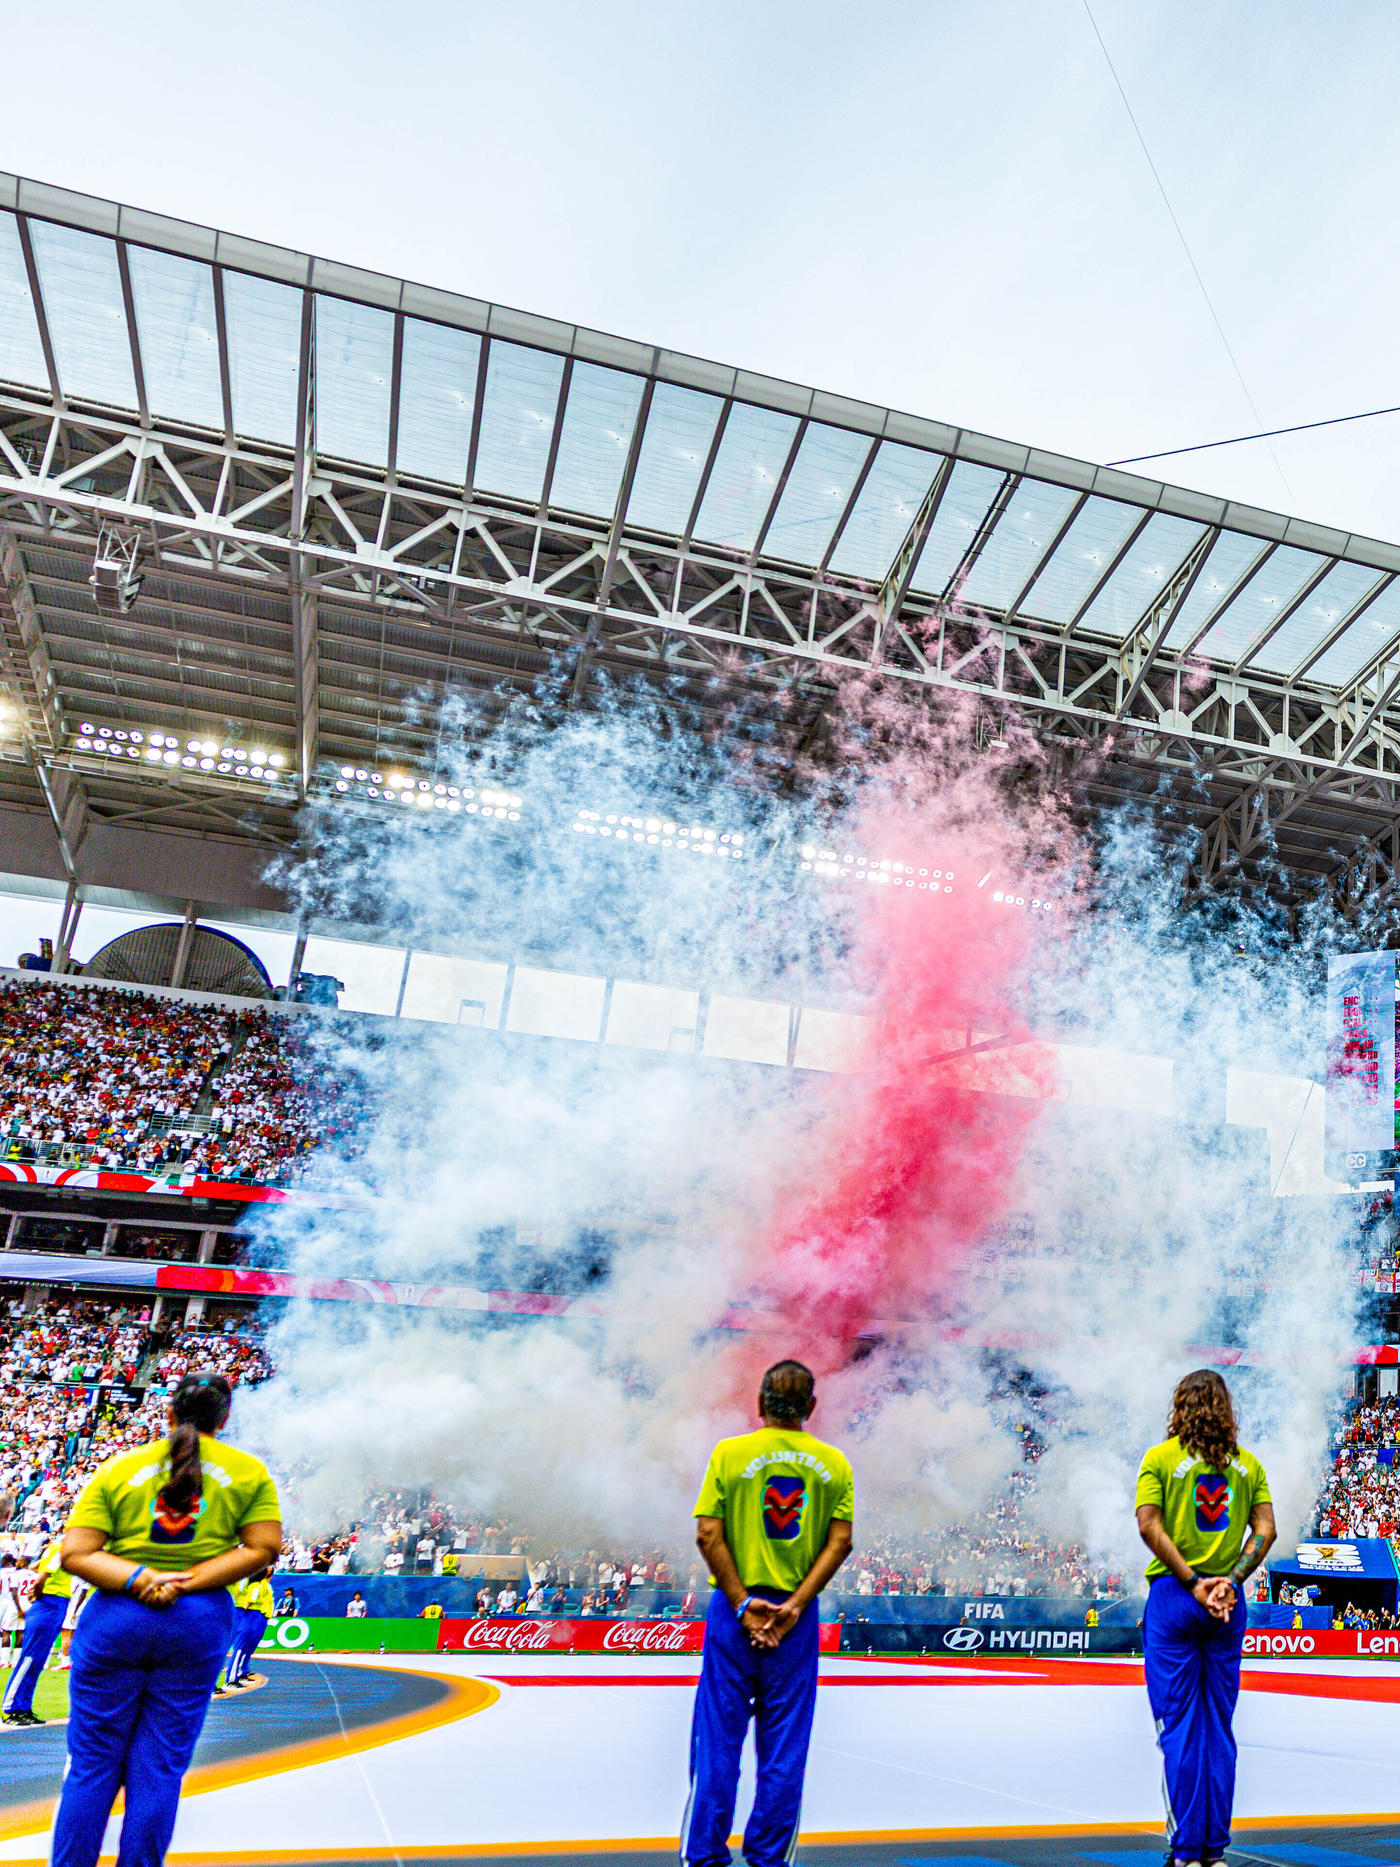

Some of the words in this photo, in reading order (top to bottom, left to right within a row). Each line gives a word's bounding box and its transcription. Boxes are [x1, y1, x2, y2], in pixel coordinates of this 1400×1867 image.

[964, 1602, 1005, 1619] FIFA
[463, 1619, 557, 1649] Coca-Cola
[603, 1620, 692, 1649] Coca-Cola
[989, 1630, 1090, 1649] HYUNDAI
[1243, 1635, 1315, 1653] enovo
